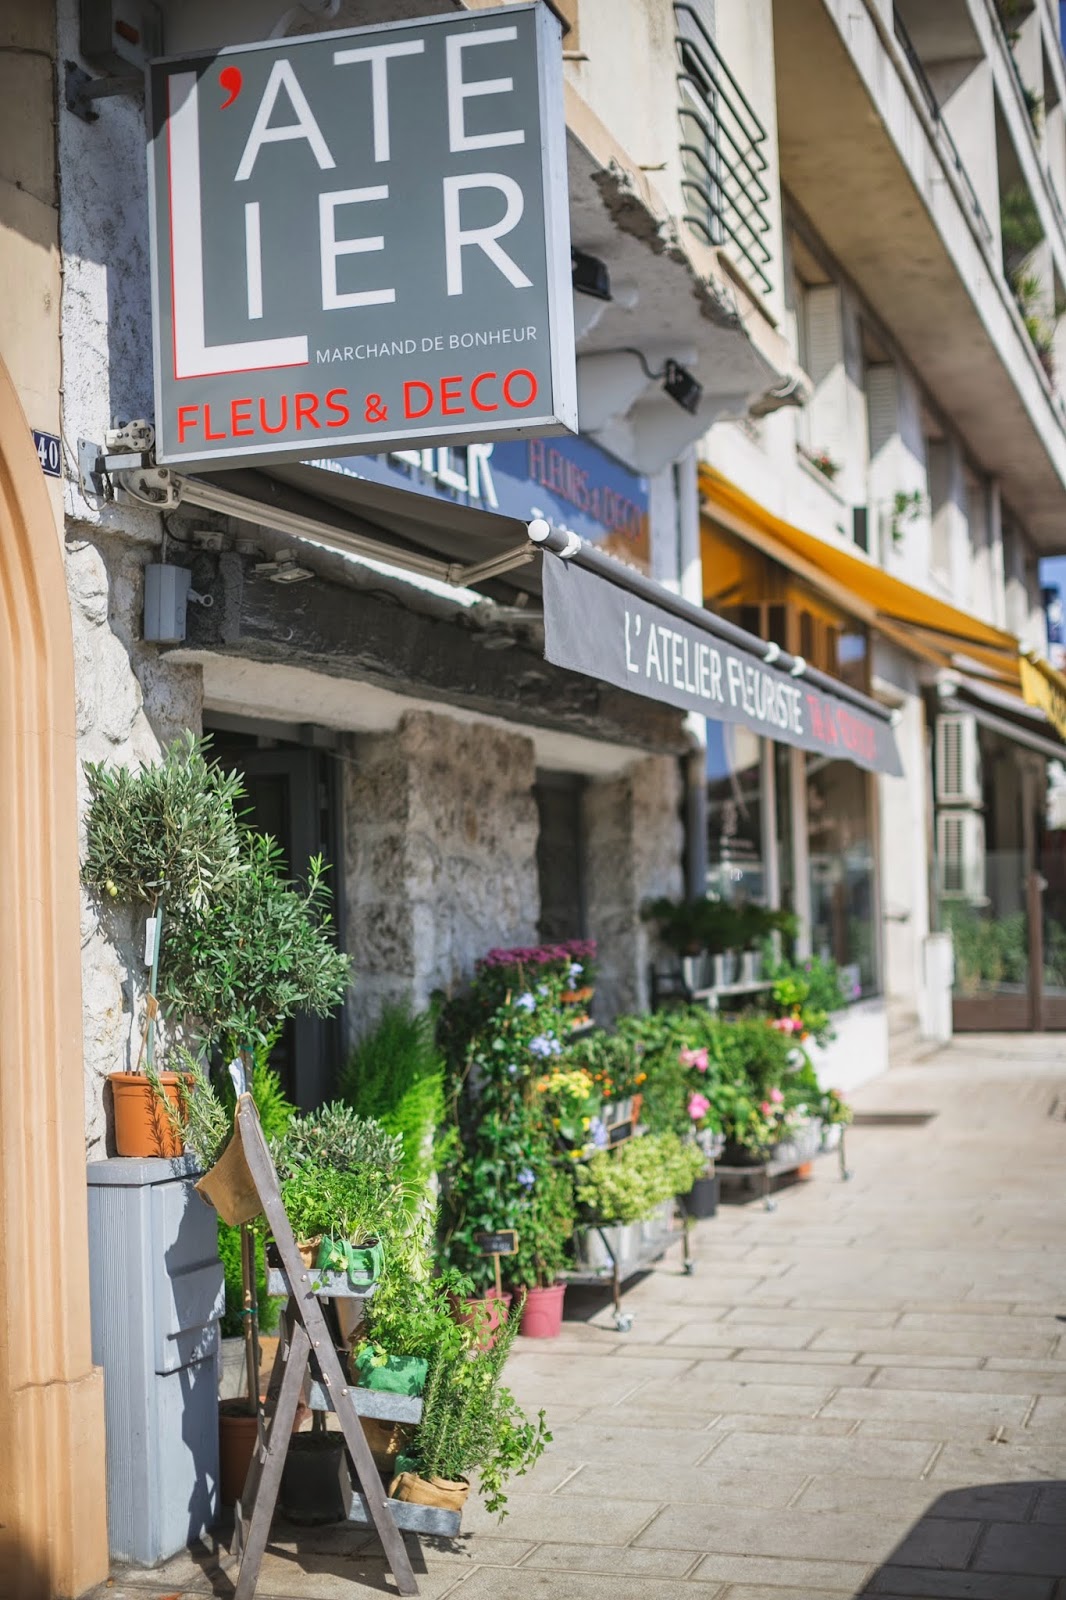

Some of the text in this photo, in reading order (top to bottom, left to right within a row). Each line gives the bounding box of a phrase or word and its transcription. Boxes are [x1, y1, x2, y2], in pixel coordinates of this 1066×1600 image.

[316, 326, 537, 364] MARCHAND DE BONHEUR
[177, 368, 538, 443] FLEURS & DECO
[37, 437, 58, 469] 40
[624, 611, 725, 703] L'ATELIER
[726, 656, 804, 735] FLEURISTE
